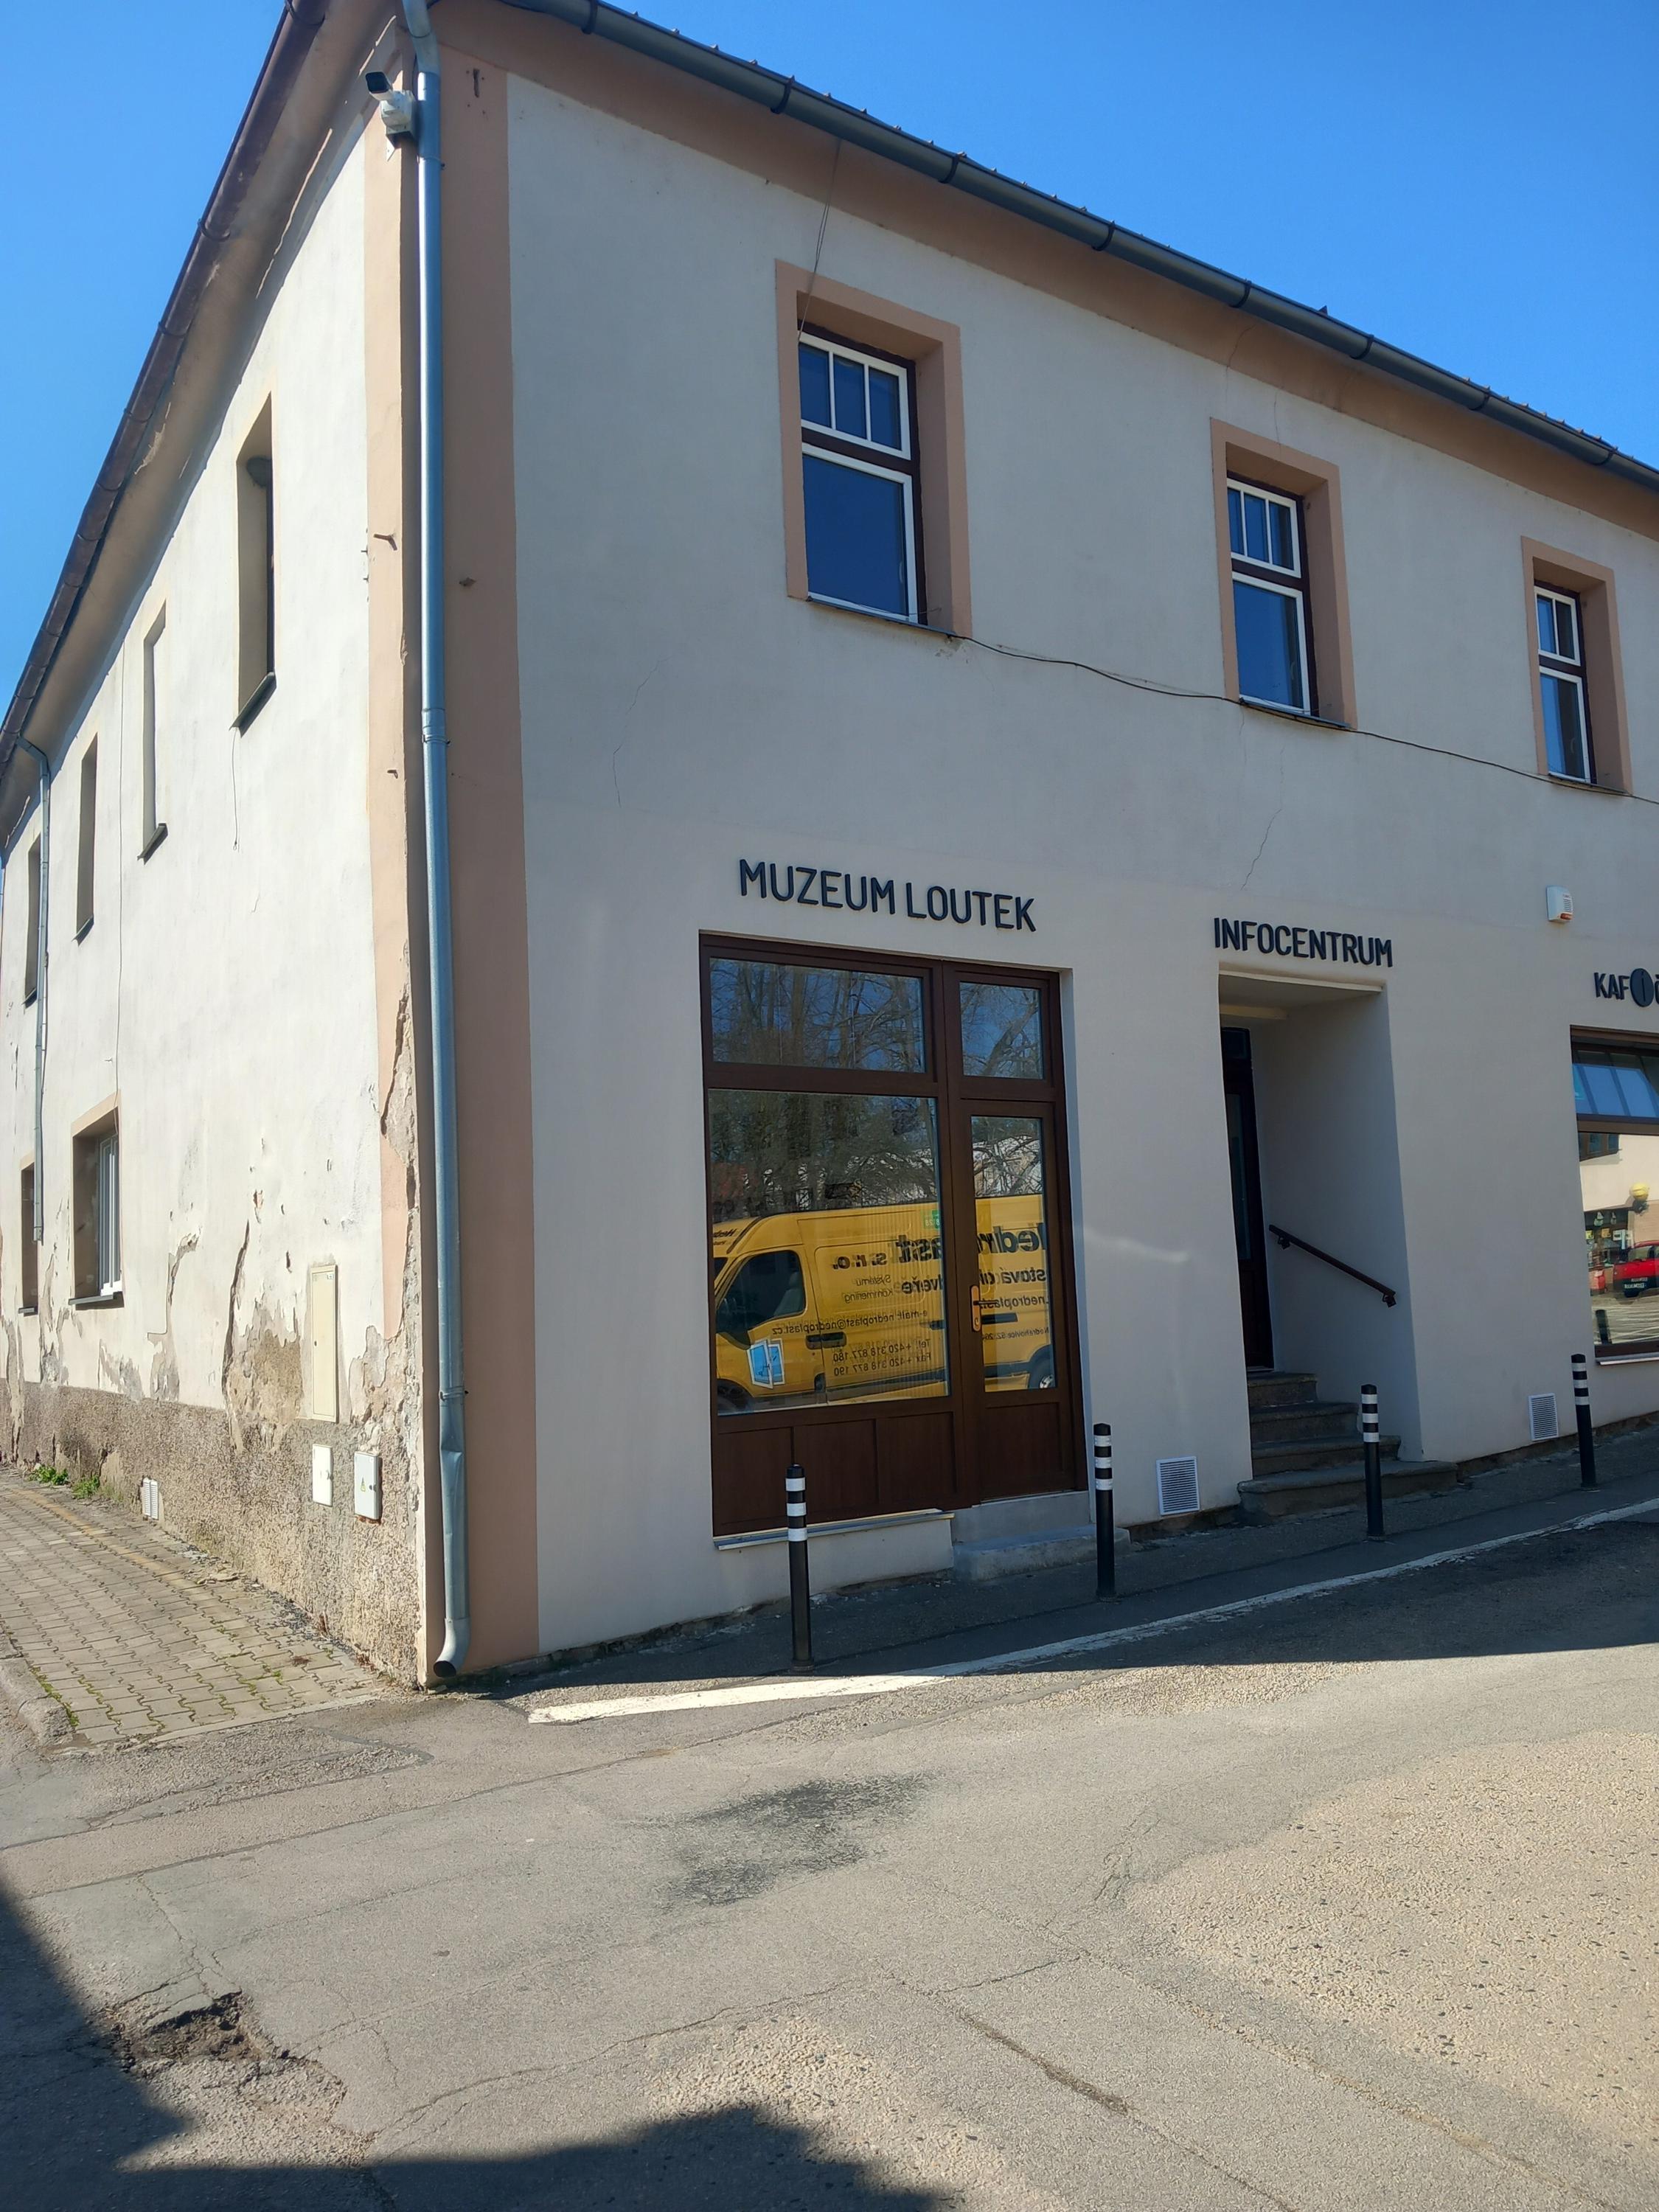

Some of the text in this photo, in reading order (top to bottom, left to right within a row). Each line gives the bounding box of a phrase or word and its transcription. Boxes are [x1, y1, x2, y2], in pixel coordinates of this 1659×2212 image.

[740, 859, 1037, 932] MUZEUM LOUTEK
[1214, 917, 1393, 967] INFOCENTRUM
